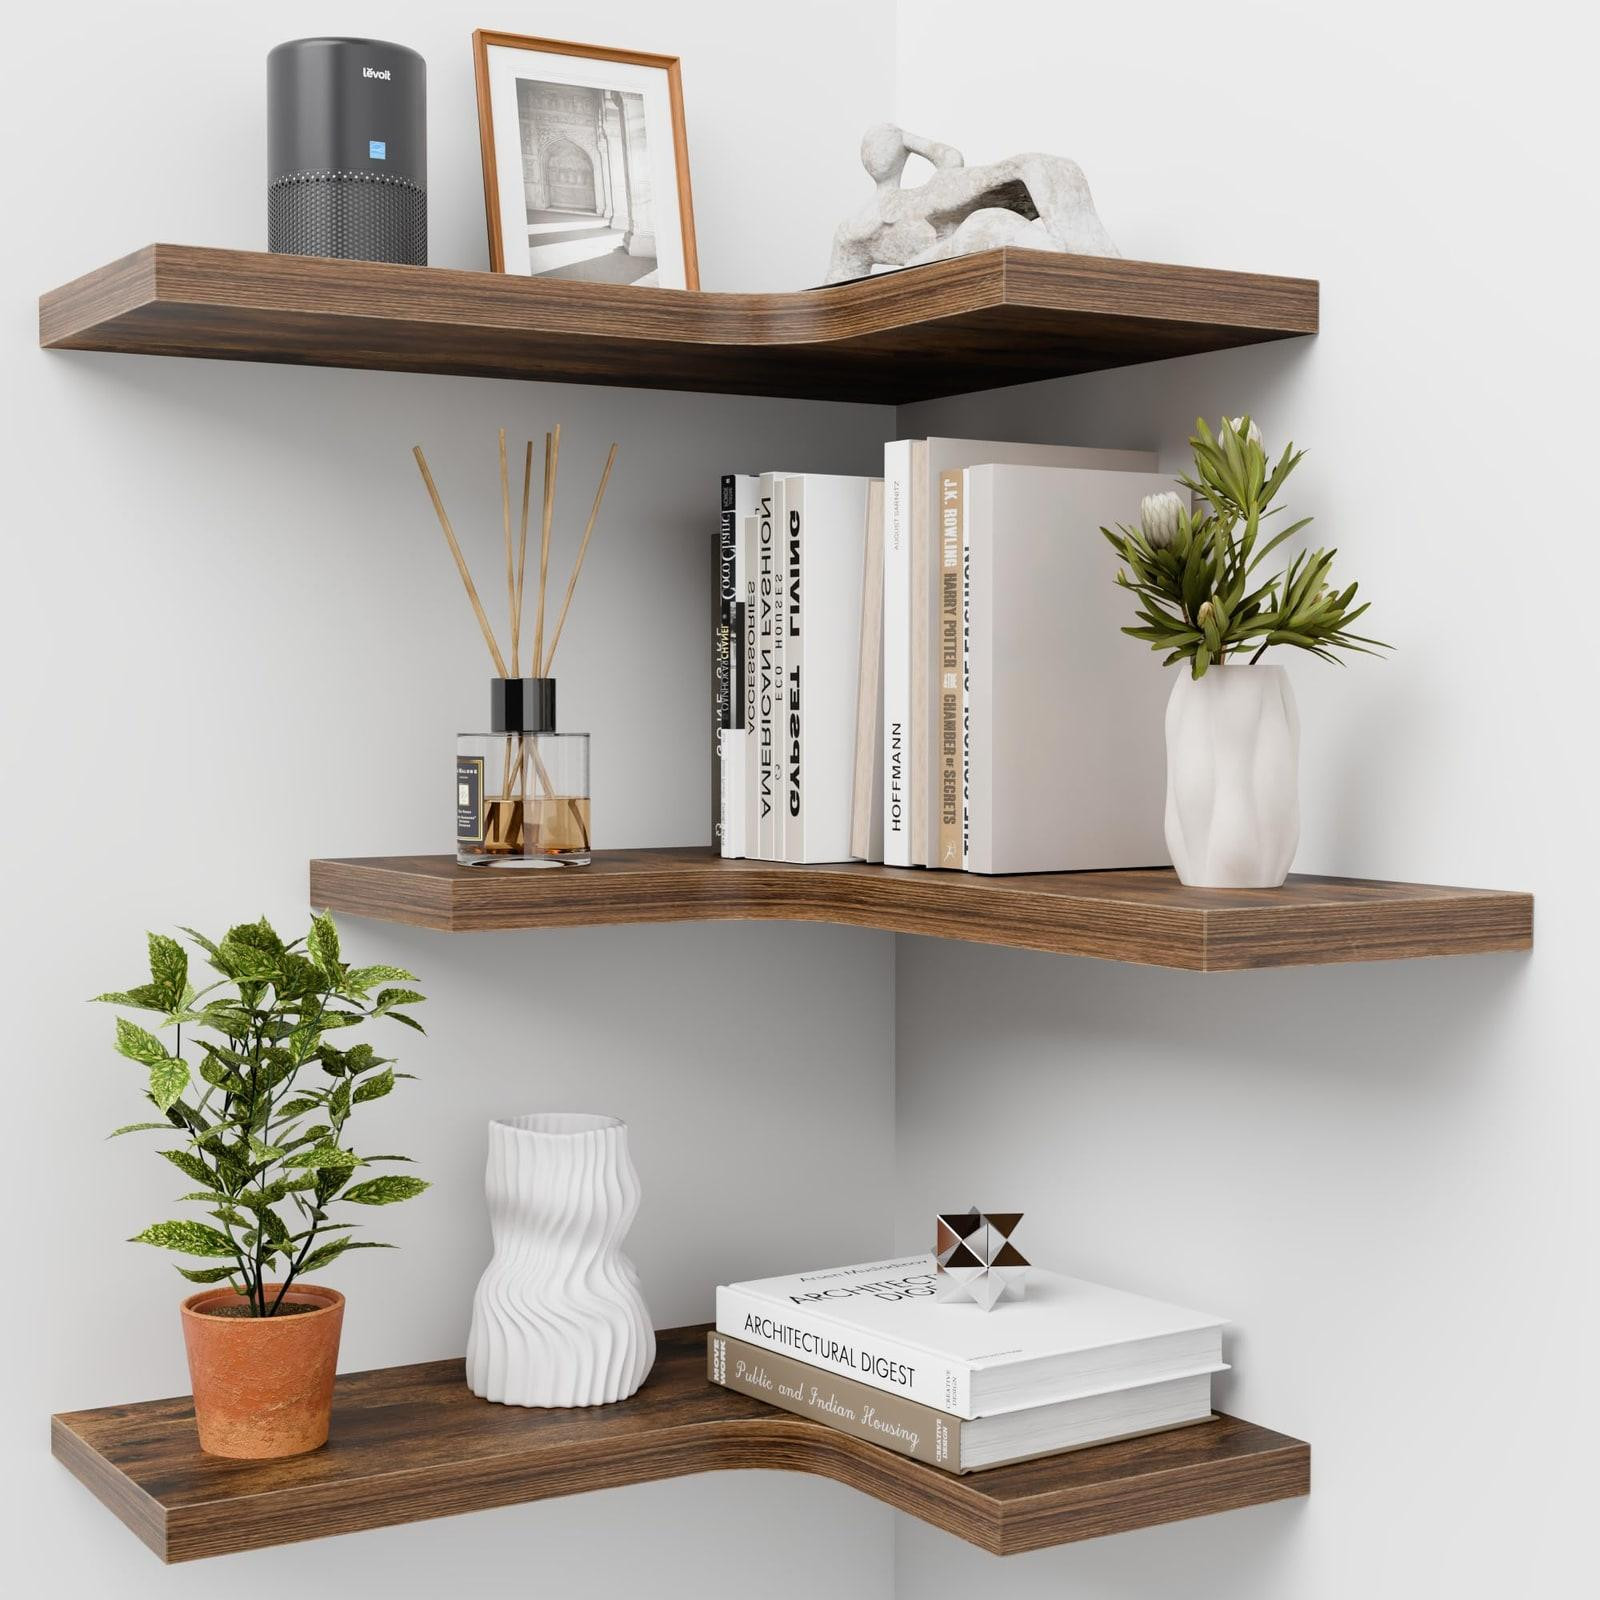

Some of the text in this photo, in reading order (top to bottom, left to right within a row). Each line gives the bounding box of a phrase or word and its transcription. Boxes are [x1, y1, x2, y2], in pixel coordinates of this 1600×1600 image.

[944, 478, 958, 506] J.K.
[944, 508, 958, 568] ROWLING
[943, 573, 958, 616] HARRY
[943, 620, 957, 668] POTTER
[943, 694, 957, 755] CHAMBER
[891, 722, 901, 831] HOFFMANN
[943, 770, 957, 825] SECRETS
[789, 1273, 937, 1305] ARCHITECT
[744, 1313, 915, 1387] ARCHITECTURAL DIGEST
[735, 1360, 920, 1453] Public and Indian Housing
